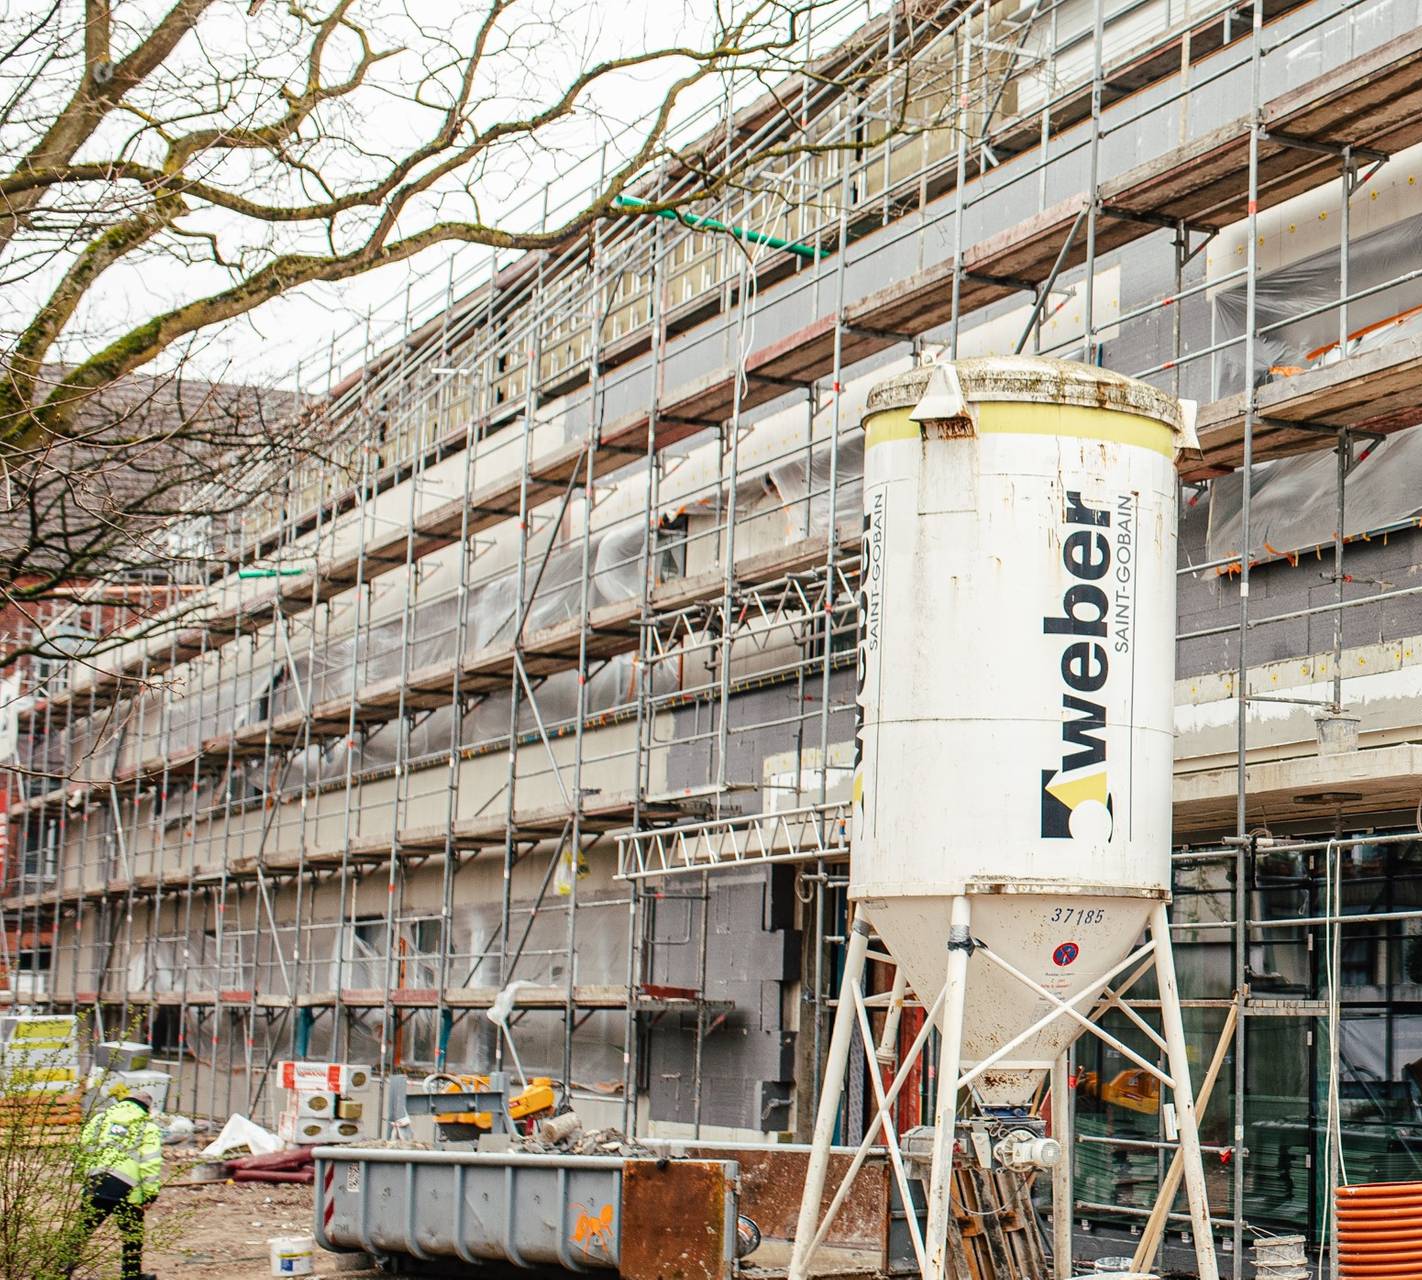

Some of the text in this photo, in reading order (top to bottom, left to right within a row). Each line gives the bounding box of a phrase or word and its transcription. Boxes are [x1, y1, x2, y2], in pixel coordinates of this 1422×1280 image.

[870, 494, 882, 651] SAINT-GOBAIN
[1043, 490, 1111, 773] weber
[1115, 495, 1131, 653] SAINT-GOBAIN
[1051, 907, 1105, 925] 37185
